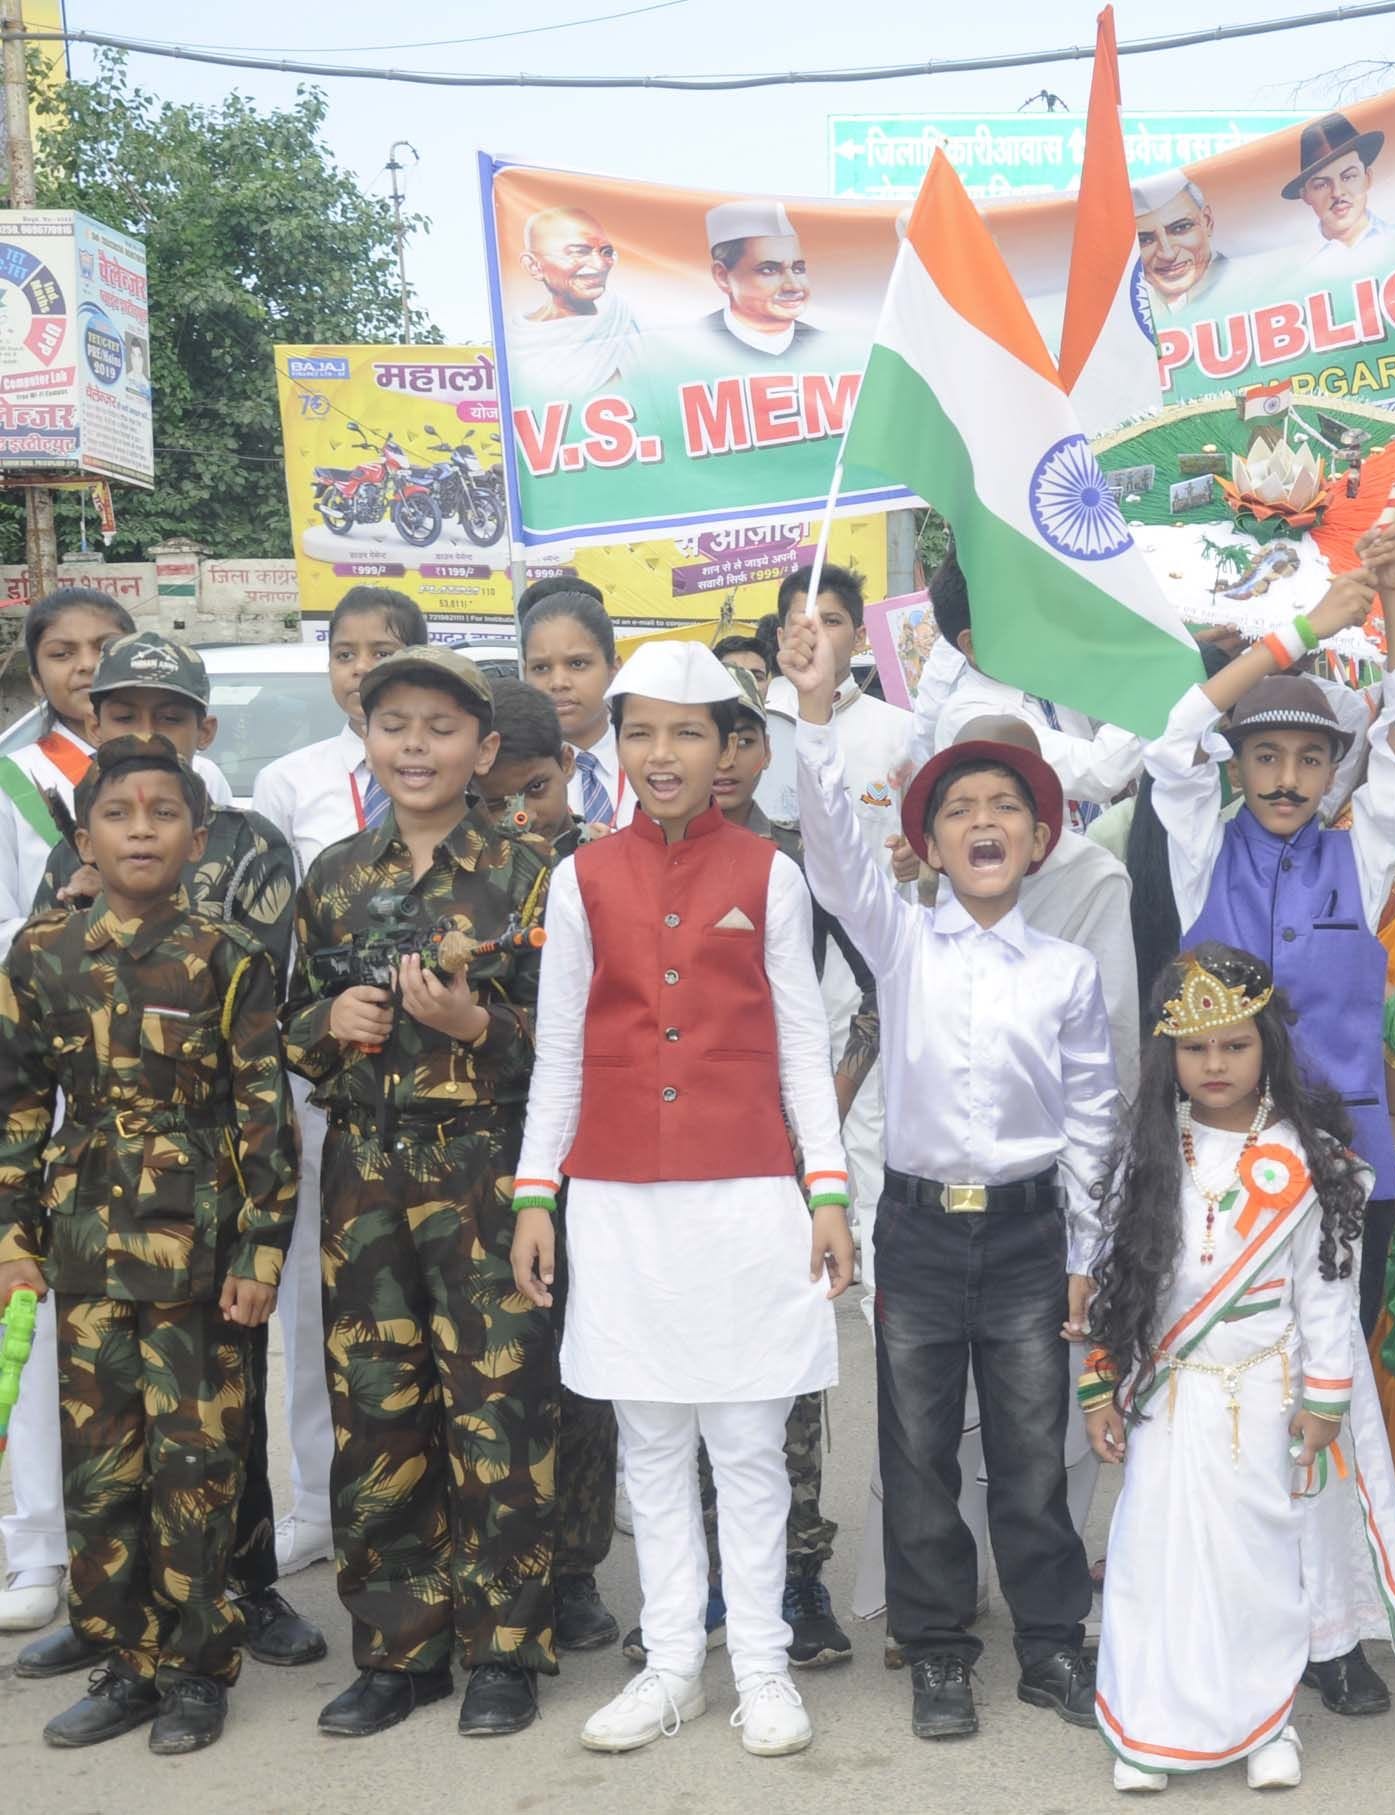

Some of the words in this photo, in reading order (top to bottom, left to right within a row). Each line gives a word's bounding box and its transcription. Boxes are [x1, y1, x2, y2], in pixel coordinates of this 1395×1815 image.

[37, 322, 62, 357] UPP
[291, 361, 345, 371] BAJAJ
[3, 373, 49, 390] Computer
[50, 370, 68, 384] Lab
[511, 394, 662, 477] V.S.
[678, 371, 863, 458] MEM
[207, 564, 249, 586] जिला
